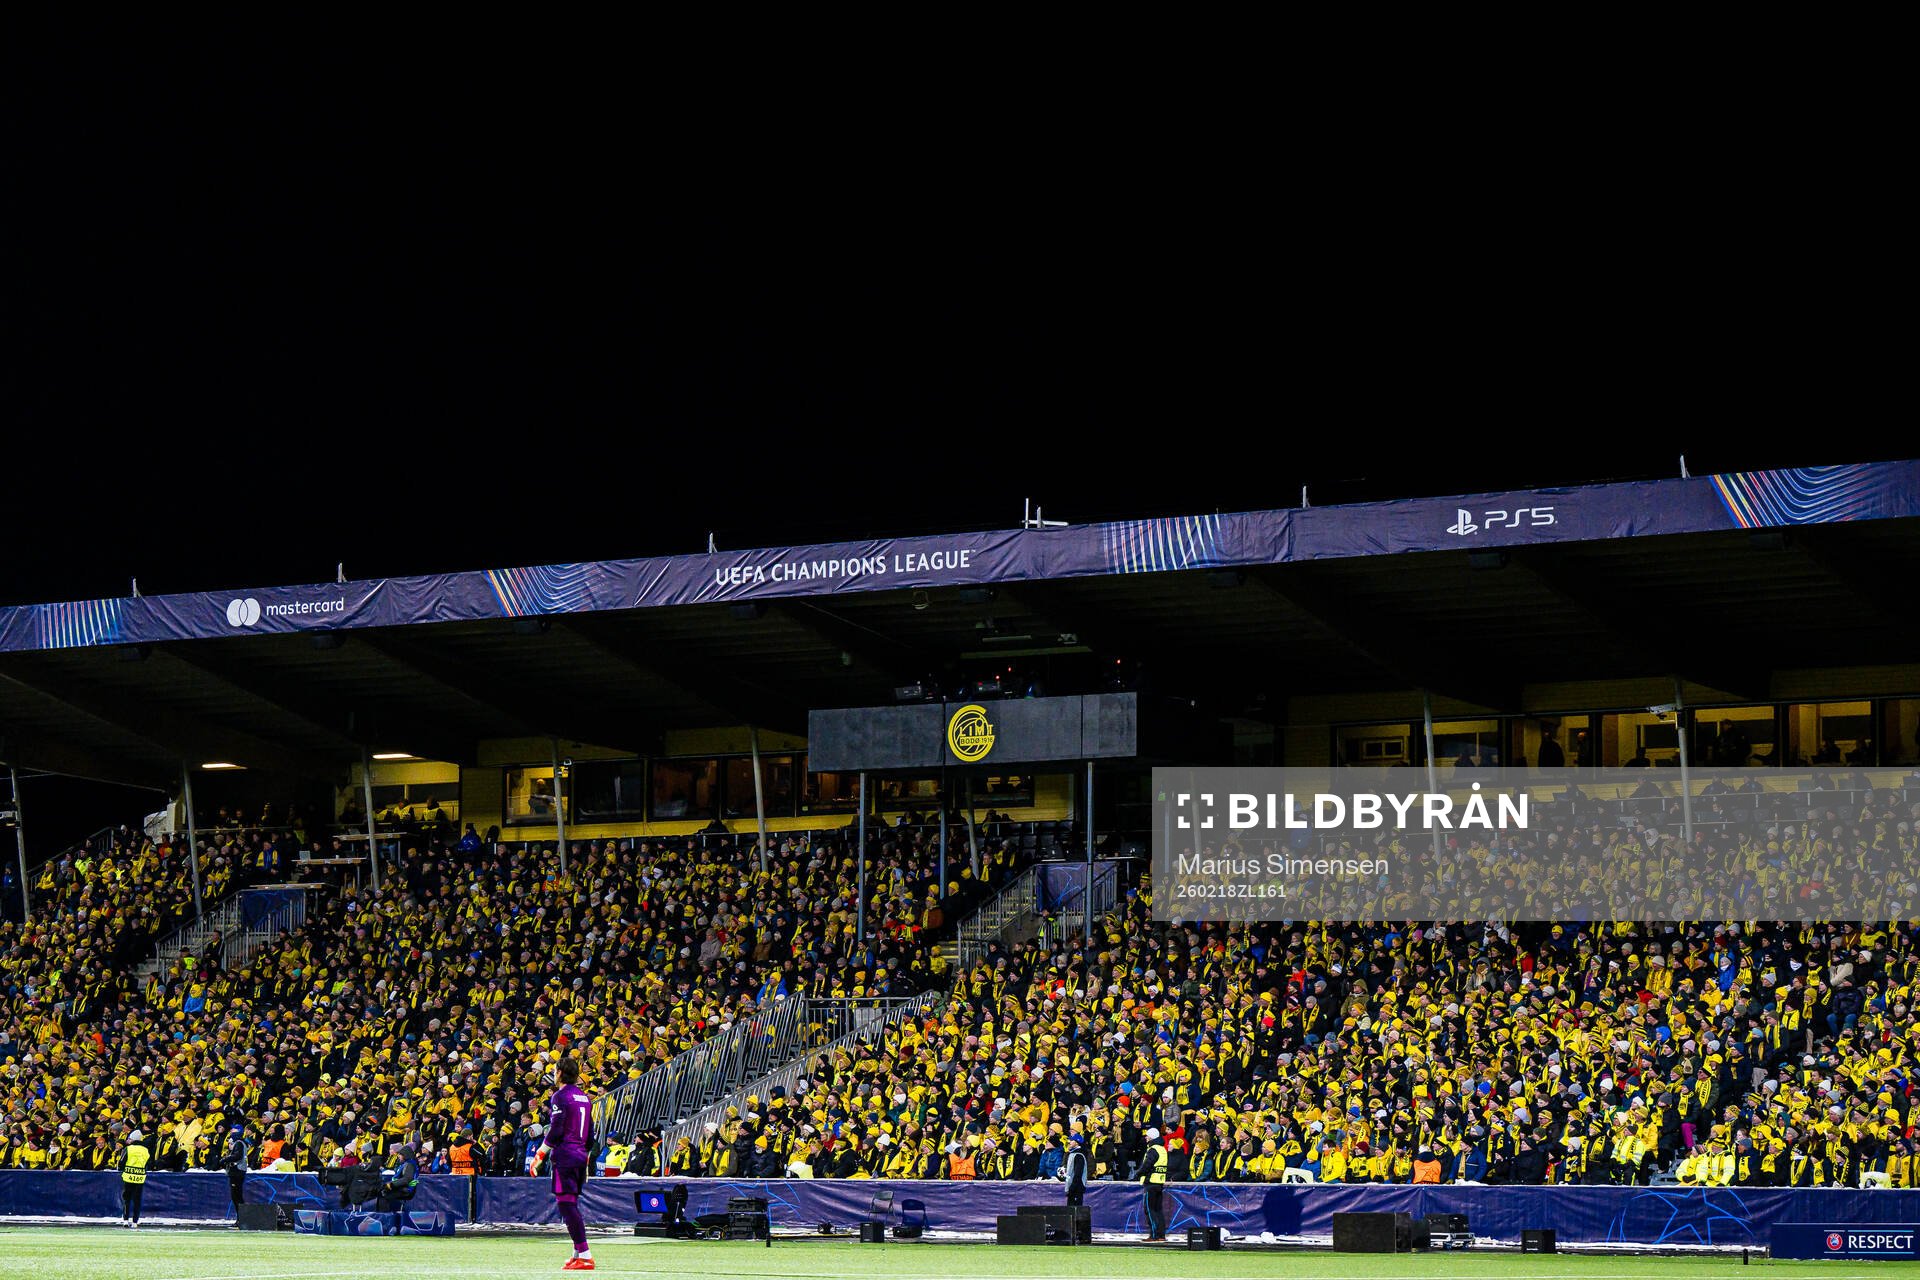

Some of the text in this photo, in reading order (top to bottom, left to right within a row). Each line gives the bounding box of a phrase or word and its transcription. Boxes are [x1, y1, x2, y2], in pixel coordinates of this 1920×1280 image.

[1484, 506, 1555, 530] PS5
[716, 549, 971, 586] UEFA CHAMPIONS LEAGUE
[266, 596, 345, 616] mastercard
[579, 1106, 586, 1138] 1
[1848, 1235, 1914, 1249] RESPECT
